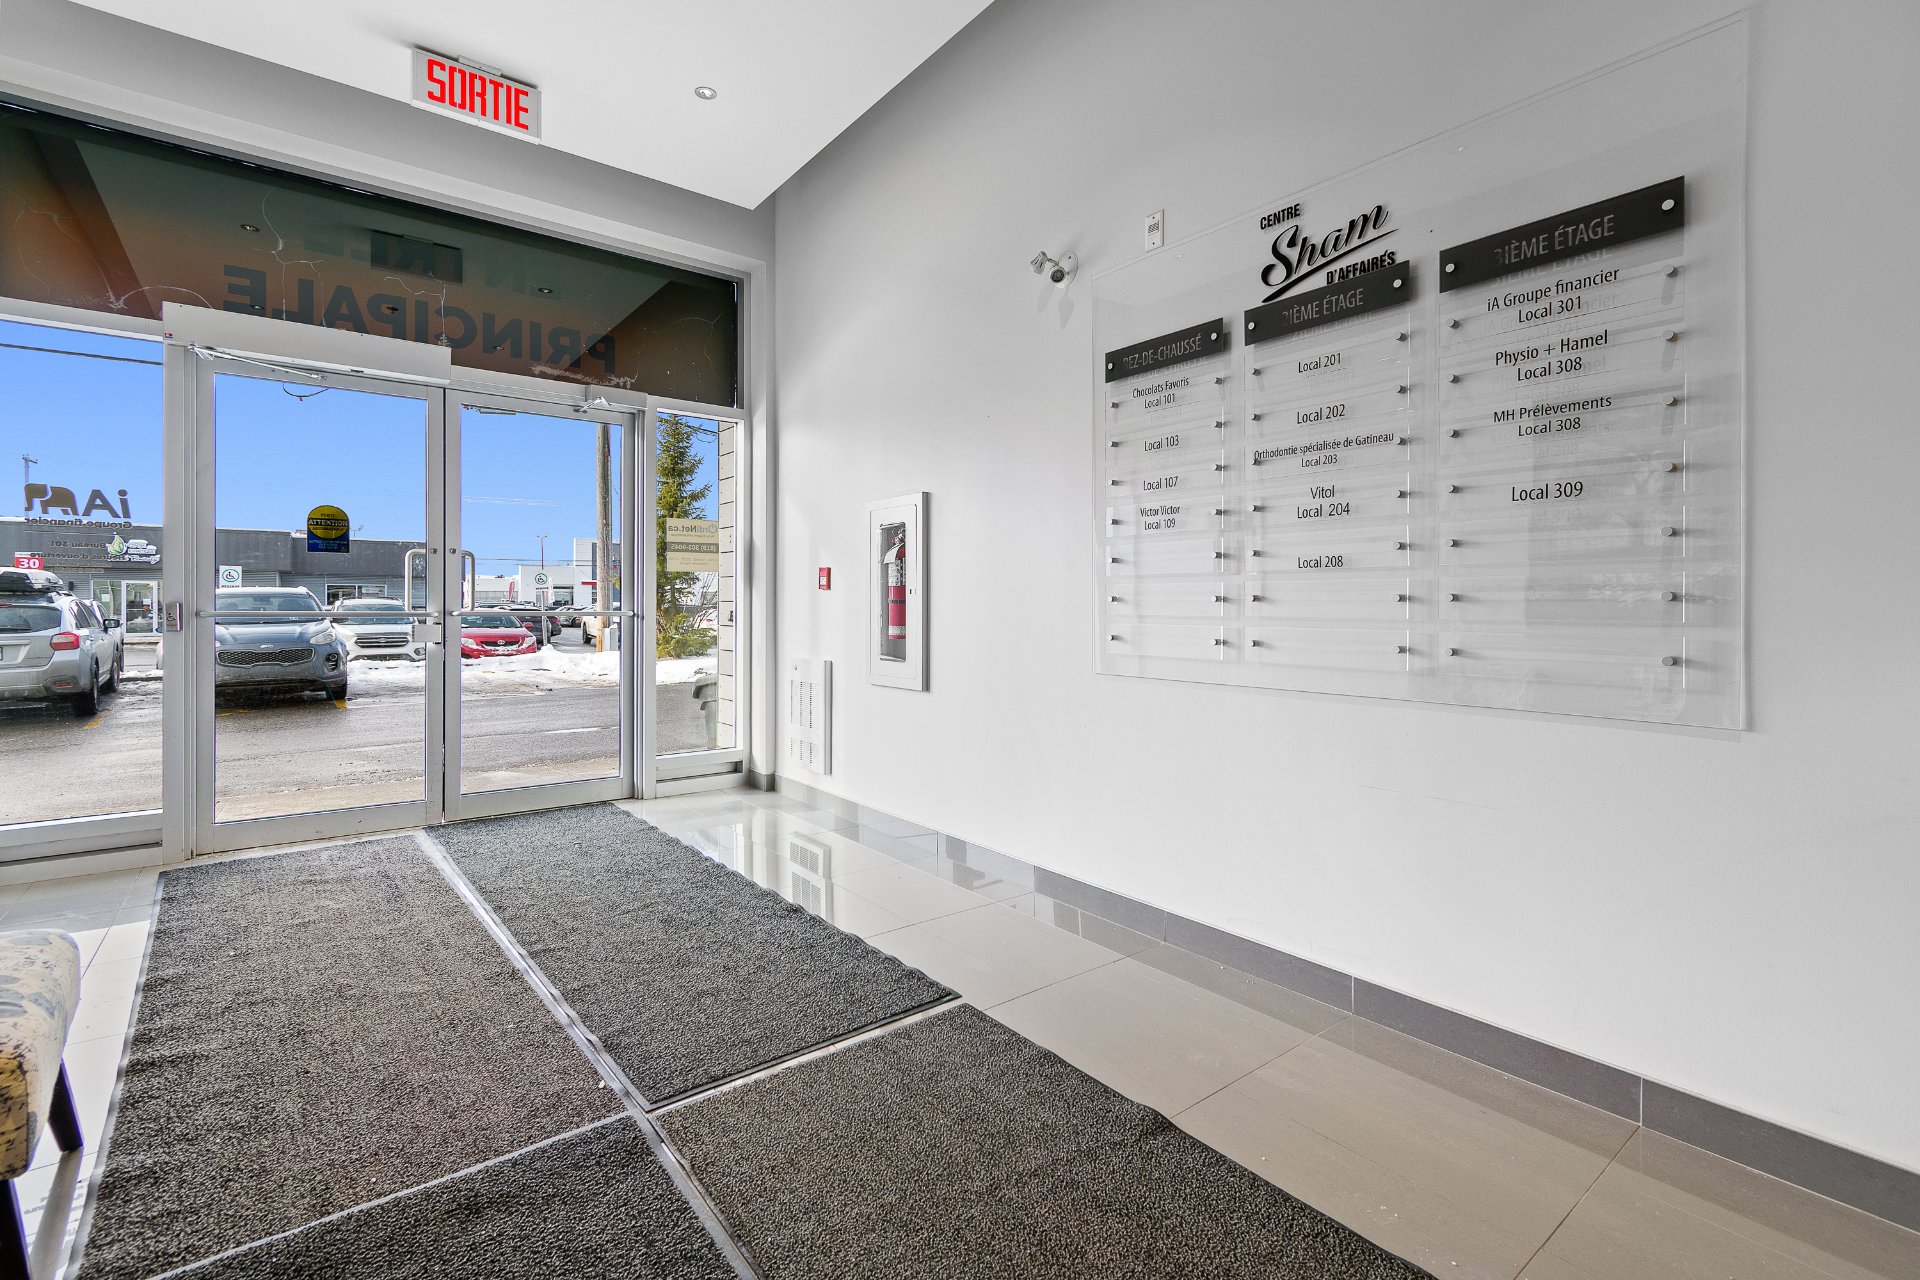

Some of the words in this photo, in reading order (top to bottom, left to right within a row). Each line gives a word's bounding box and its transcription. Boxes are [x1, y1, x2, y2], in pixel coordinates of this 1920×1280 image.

[427, 57, 530, 131] SORTIE
[1260, 203, 1301, 231] CENTRE
[1554, 213, 1615, 251] ÉTAGE
[1260, 204, 1390, 289] Sham
[1486, 292, 1500, 312] iA
[1503, 286, 1552, 307] Groupe
[1556, 268, 1620, 294] financier
[1323, 288, 1365, 316] ÉTAGE
[1518, 302, 1552, 323] Local
[1556, 296, 1582, 315] 301
[1495, 344, 1539, 366] Physio
[1543, 344, 1556, 356] +
[1560, 330, 1608, 352] Hamel
[1298, 355, 1322, 374] Local
[1323, 352, 1342, 369] 201
[1517, 361, 1552, 382] Local
[1556, 357, 1583, 375] 308
[1132, 382, 1164, 400] Chocolats
[1165, 376, 1190, 392] Favoris
[1144, 394, 1162, 409] Local
[1163, 392, 1176, 407] 101
[1493, 408, 1516, 423] MH
[1520, 395, 1612, 419] Prélèvements
[1297, 407, 1323, 425] Local
[1325, 404, 1346, 421] 202
[1518, 421, 1552, 437] Local
[1555, 417, 1582, 433] 308
[1144, 437, 1163, 452] Local
[1165, 435, 1179, 449] 103
[1254, 444, 1298, 461] Orthodontie
[1299, 438, 1342, 456] spécialisée
[1343, 436, 1354, 448] de
[1355, 432, 1395, 447] Gatineau
[1301, 455, 1321, 468] Local
[1322, 453, 1338, 466] 203
[1143, 477, 1162, 491] Local
[1164, 476, 1179, 490] 107
[1310, 485, 1335, 500] Vitol
[1511, 483, 1549, 502] Local
[1554, 481, 1584, 499] 309
[1140, 506, 1160, 518] Victor
[1160, 504, 1181, 516] Victor
[1297, 504, 1323, 519] Local
[1328, 502, 1351, 518] 204
[308, 519, 348, 527] ATTENTION
[1144, 518, 1161, 531] Local
[1163, 517, 1176, 530] 109
[18, 558, 40, 568] 30
[1298, 555, 1322, 569] Local
[1324, 555, 1344, 568] 208
